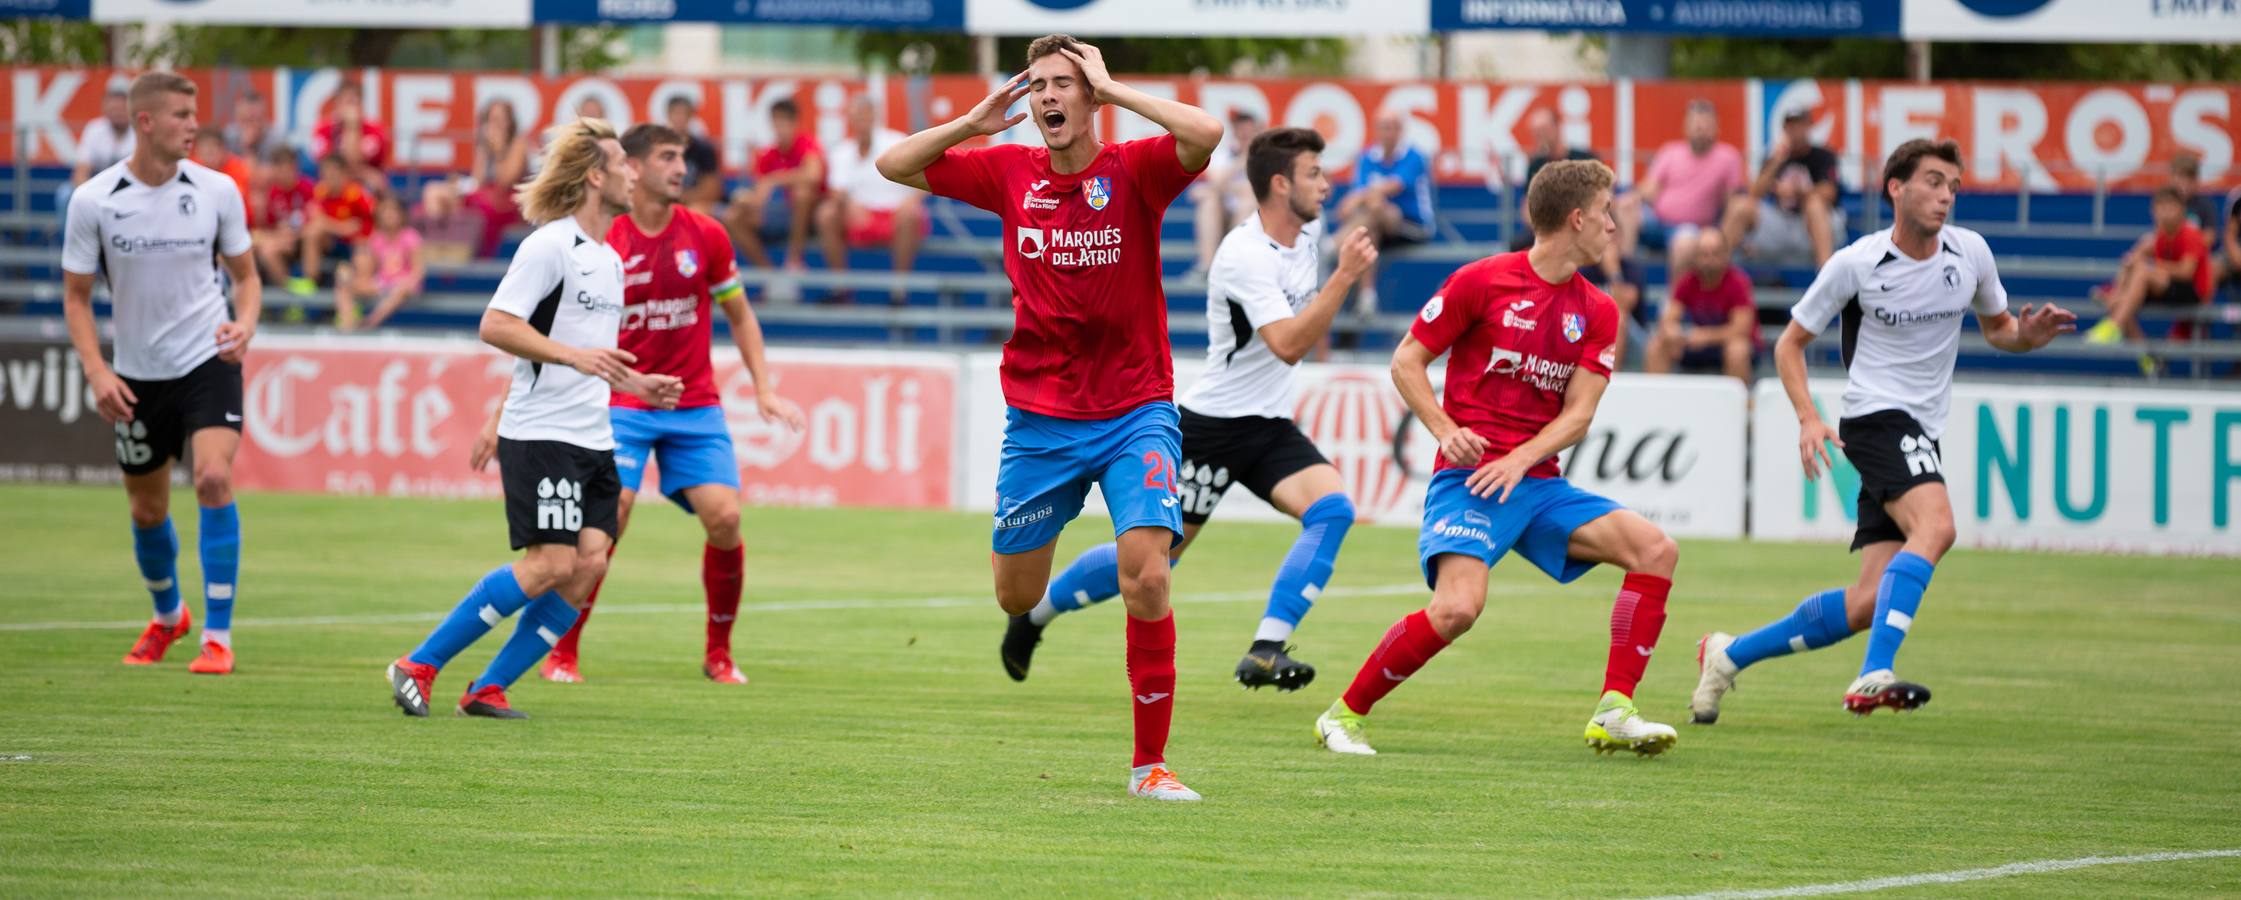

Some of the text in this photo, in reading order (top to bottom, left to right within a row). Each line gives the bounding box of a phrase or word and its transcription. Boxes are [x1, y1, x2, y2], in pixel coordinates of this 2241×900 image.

[1673, 0, 1863, 28] AUDIOVISUALES
[1053, 249, 1120, 267] DEL ATRIO
[246, 355, 453, 459] Café
[537, 498, 583, 532] nb
